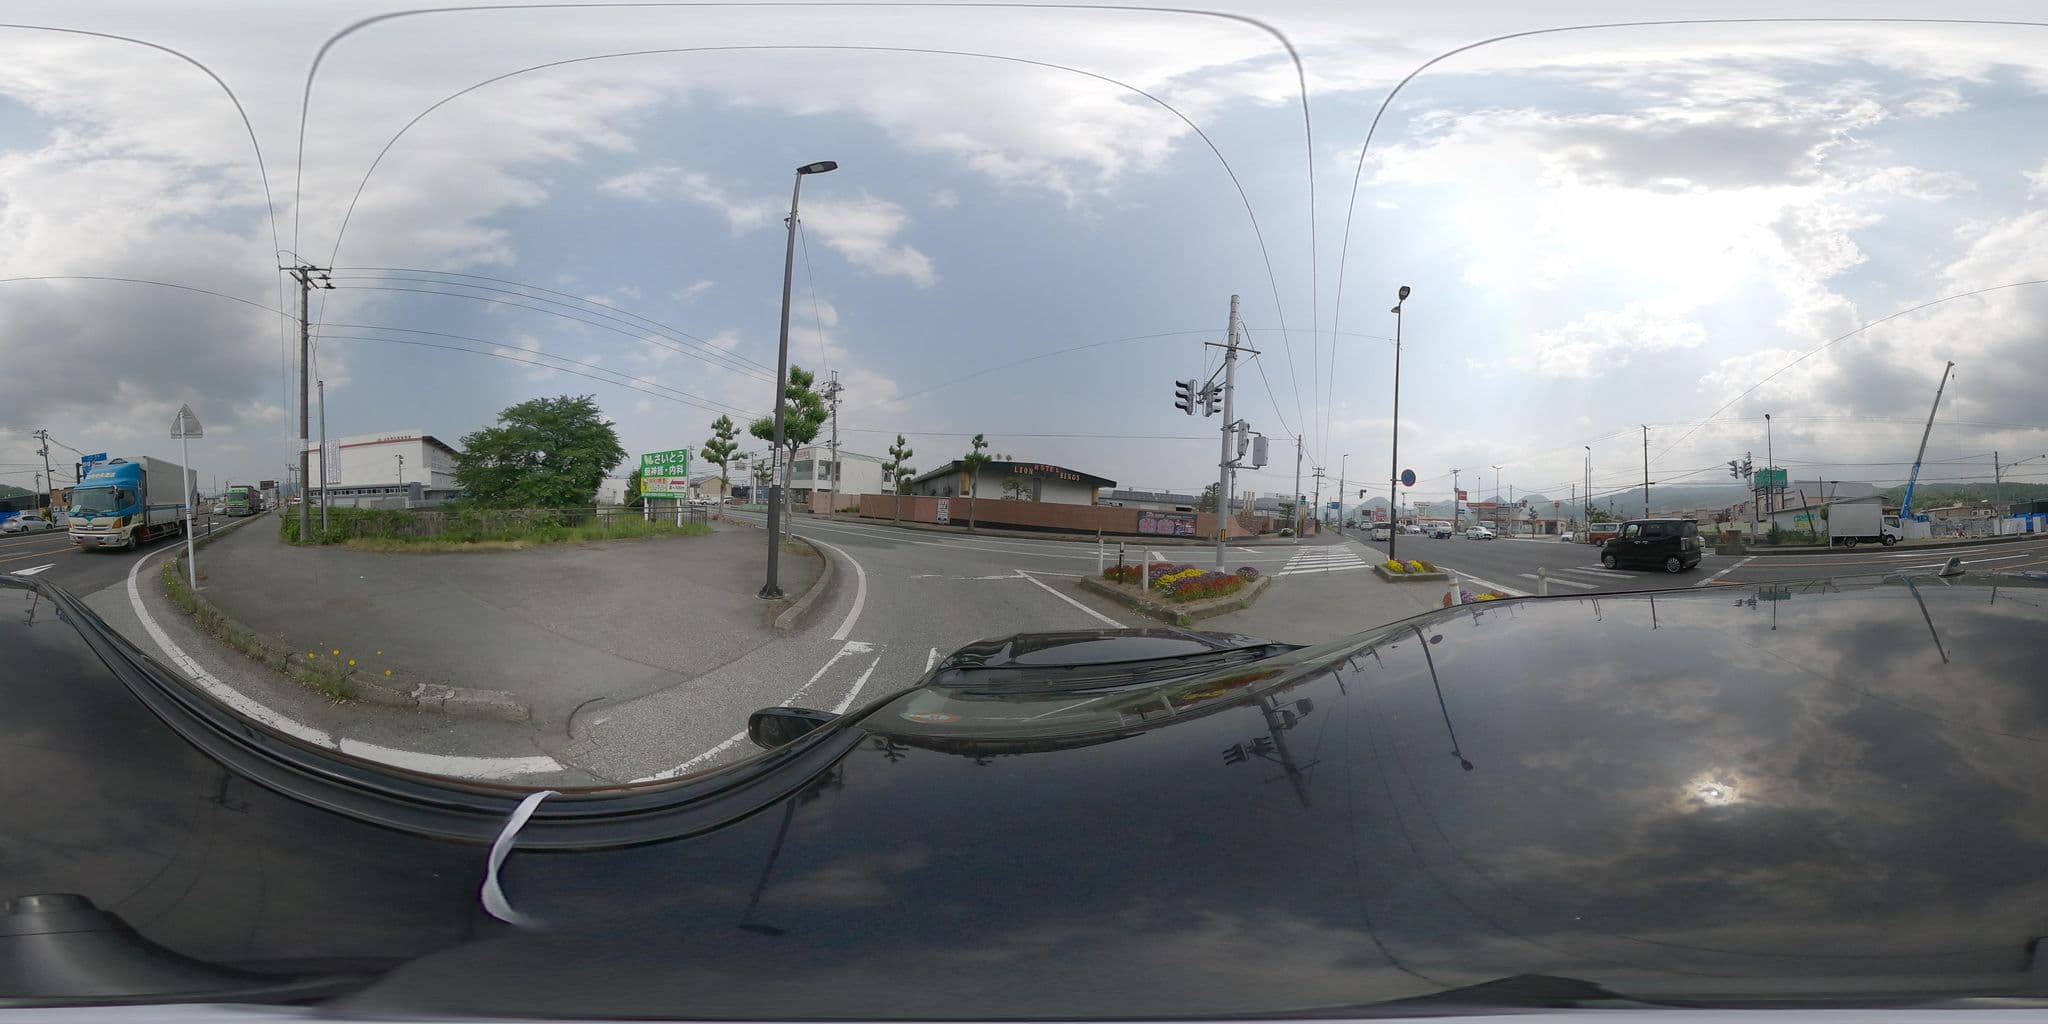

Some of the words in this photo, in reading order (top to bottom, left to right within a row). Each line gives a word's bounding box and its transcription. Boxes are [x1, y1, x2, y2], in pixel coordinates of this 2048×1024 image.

[654, 451, 684, 464] さいとう
[1014, 466, 1033, 475] LION
